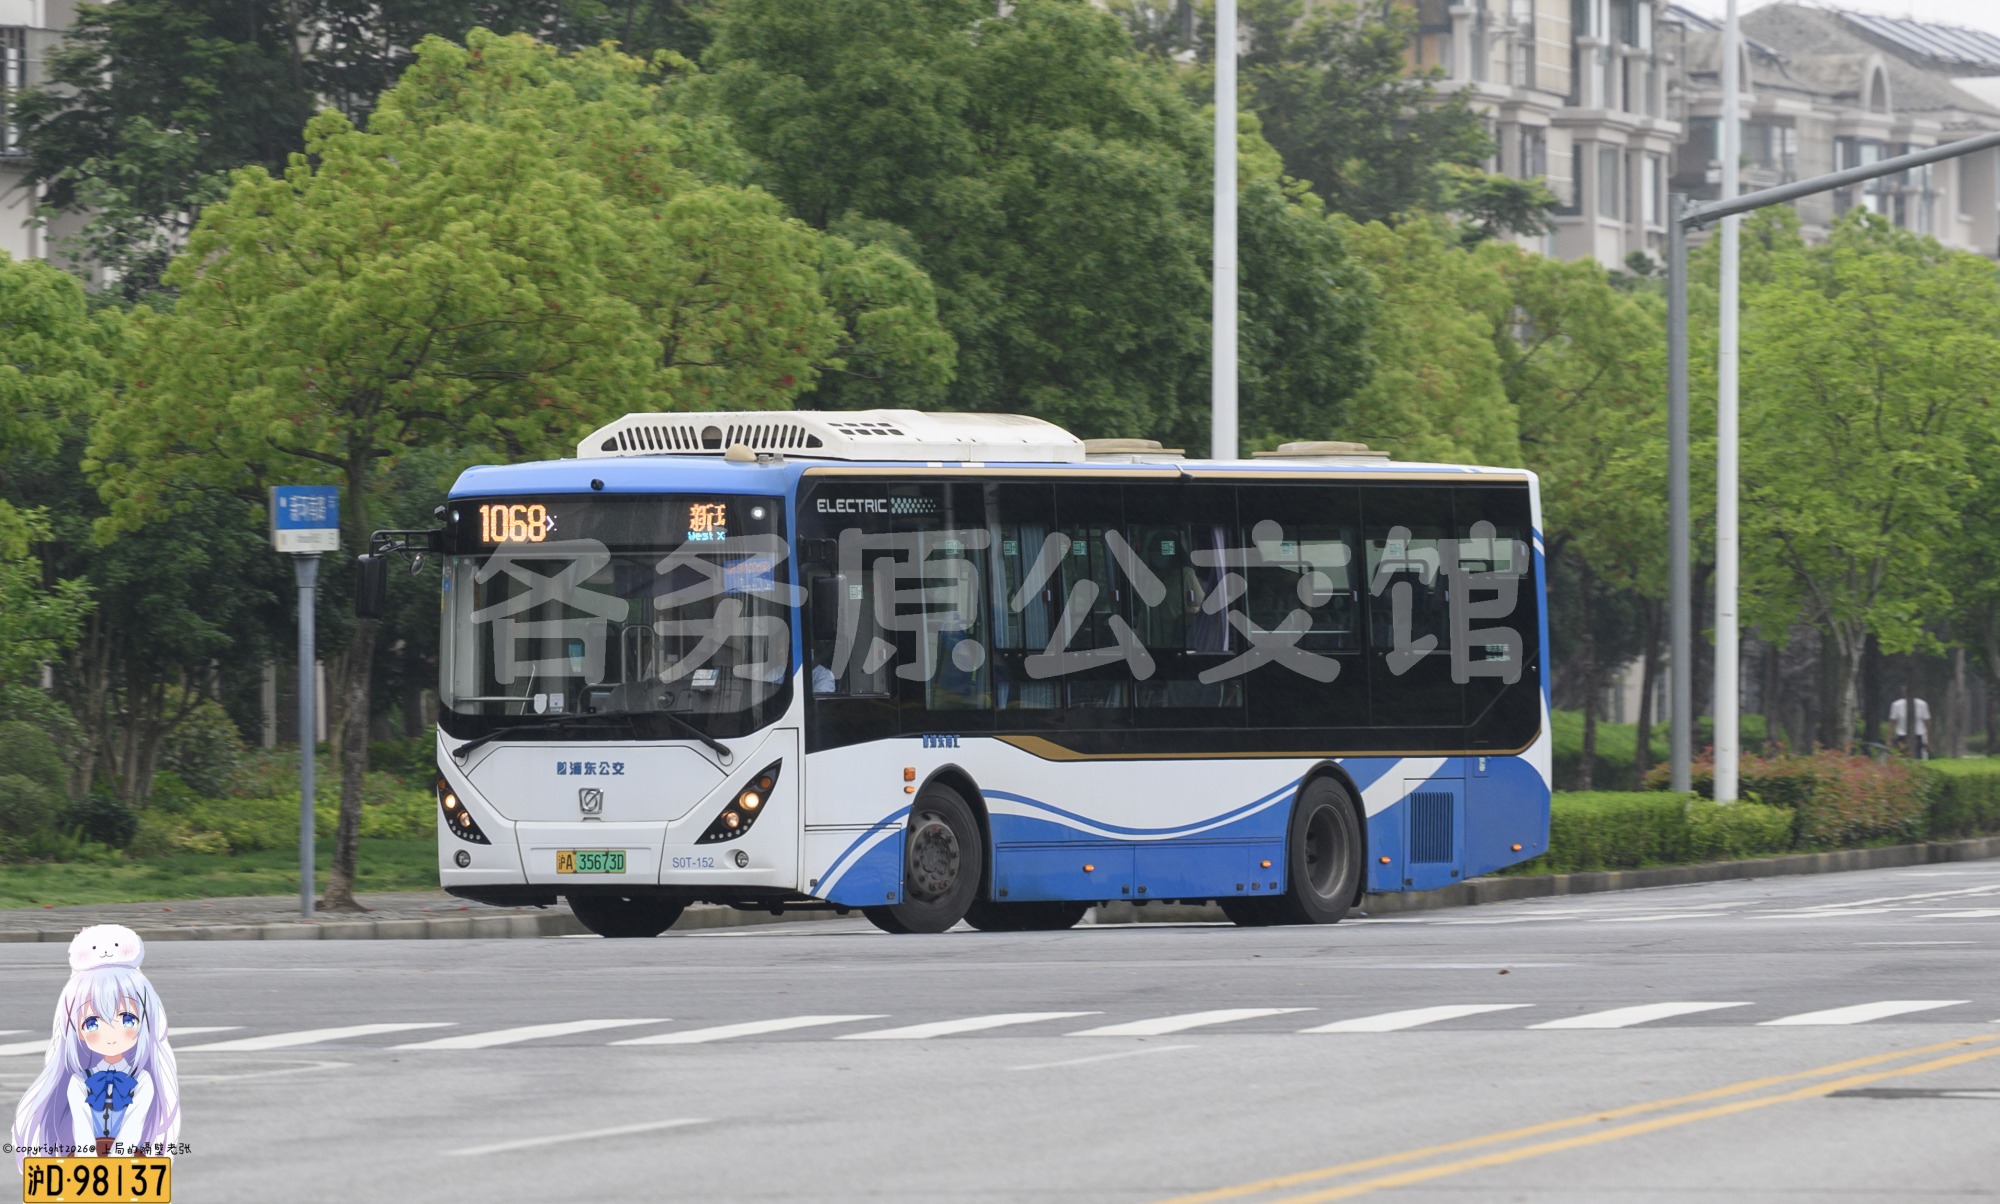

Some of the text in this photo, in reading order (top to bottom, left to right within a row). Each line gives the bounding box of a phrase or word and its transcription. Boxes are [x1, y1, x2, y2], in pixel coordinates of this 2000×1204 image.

[817, 498, 888, 513] ELECTRIC
[479, 504, 547, 543] 1068
[687, 531, 714, 541] West
[569, 761, 625, 775] 浦东公交
